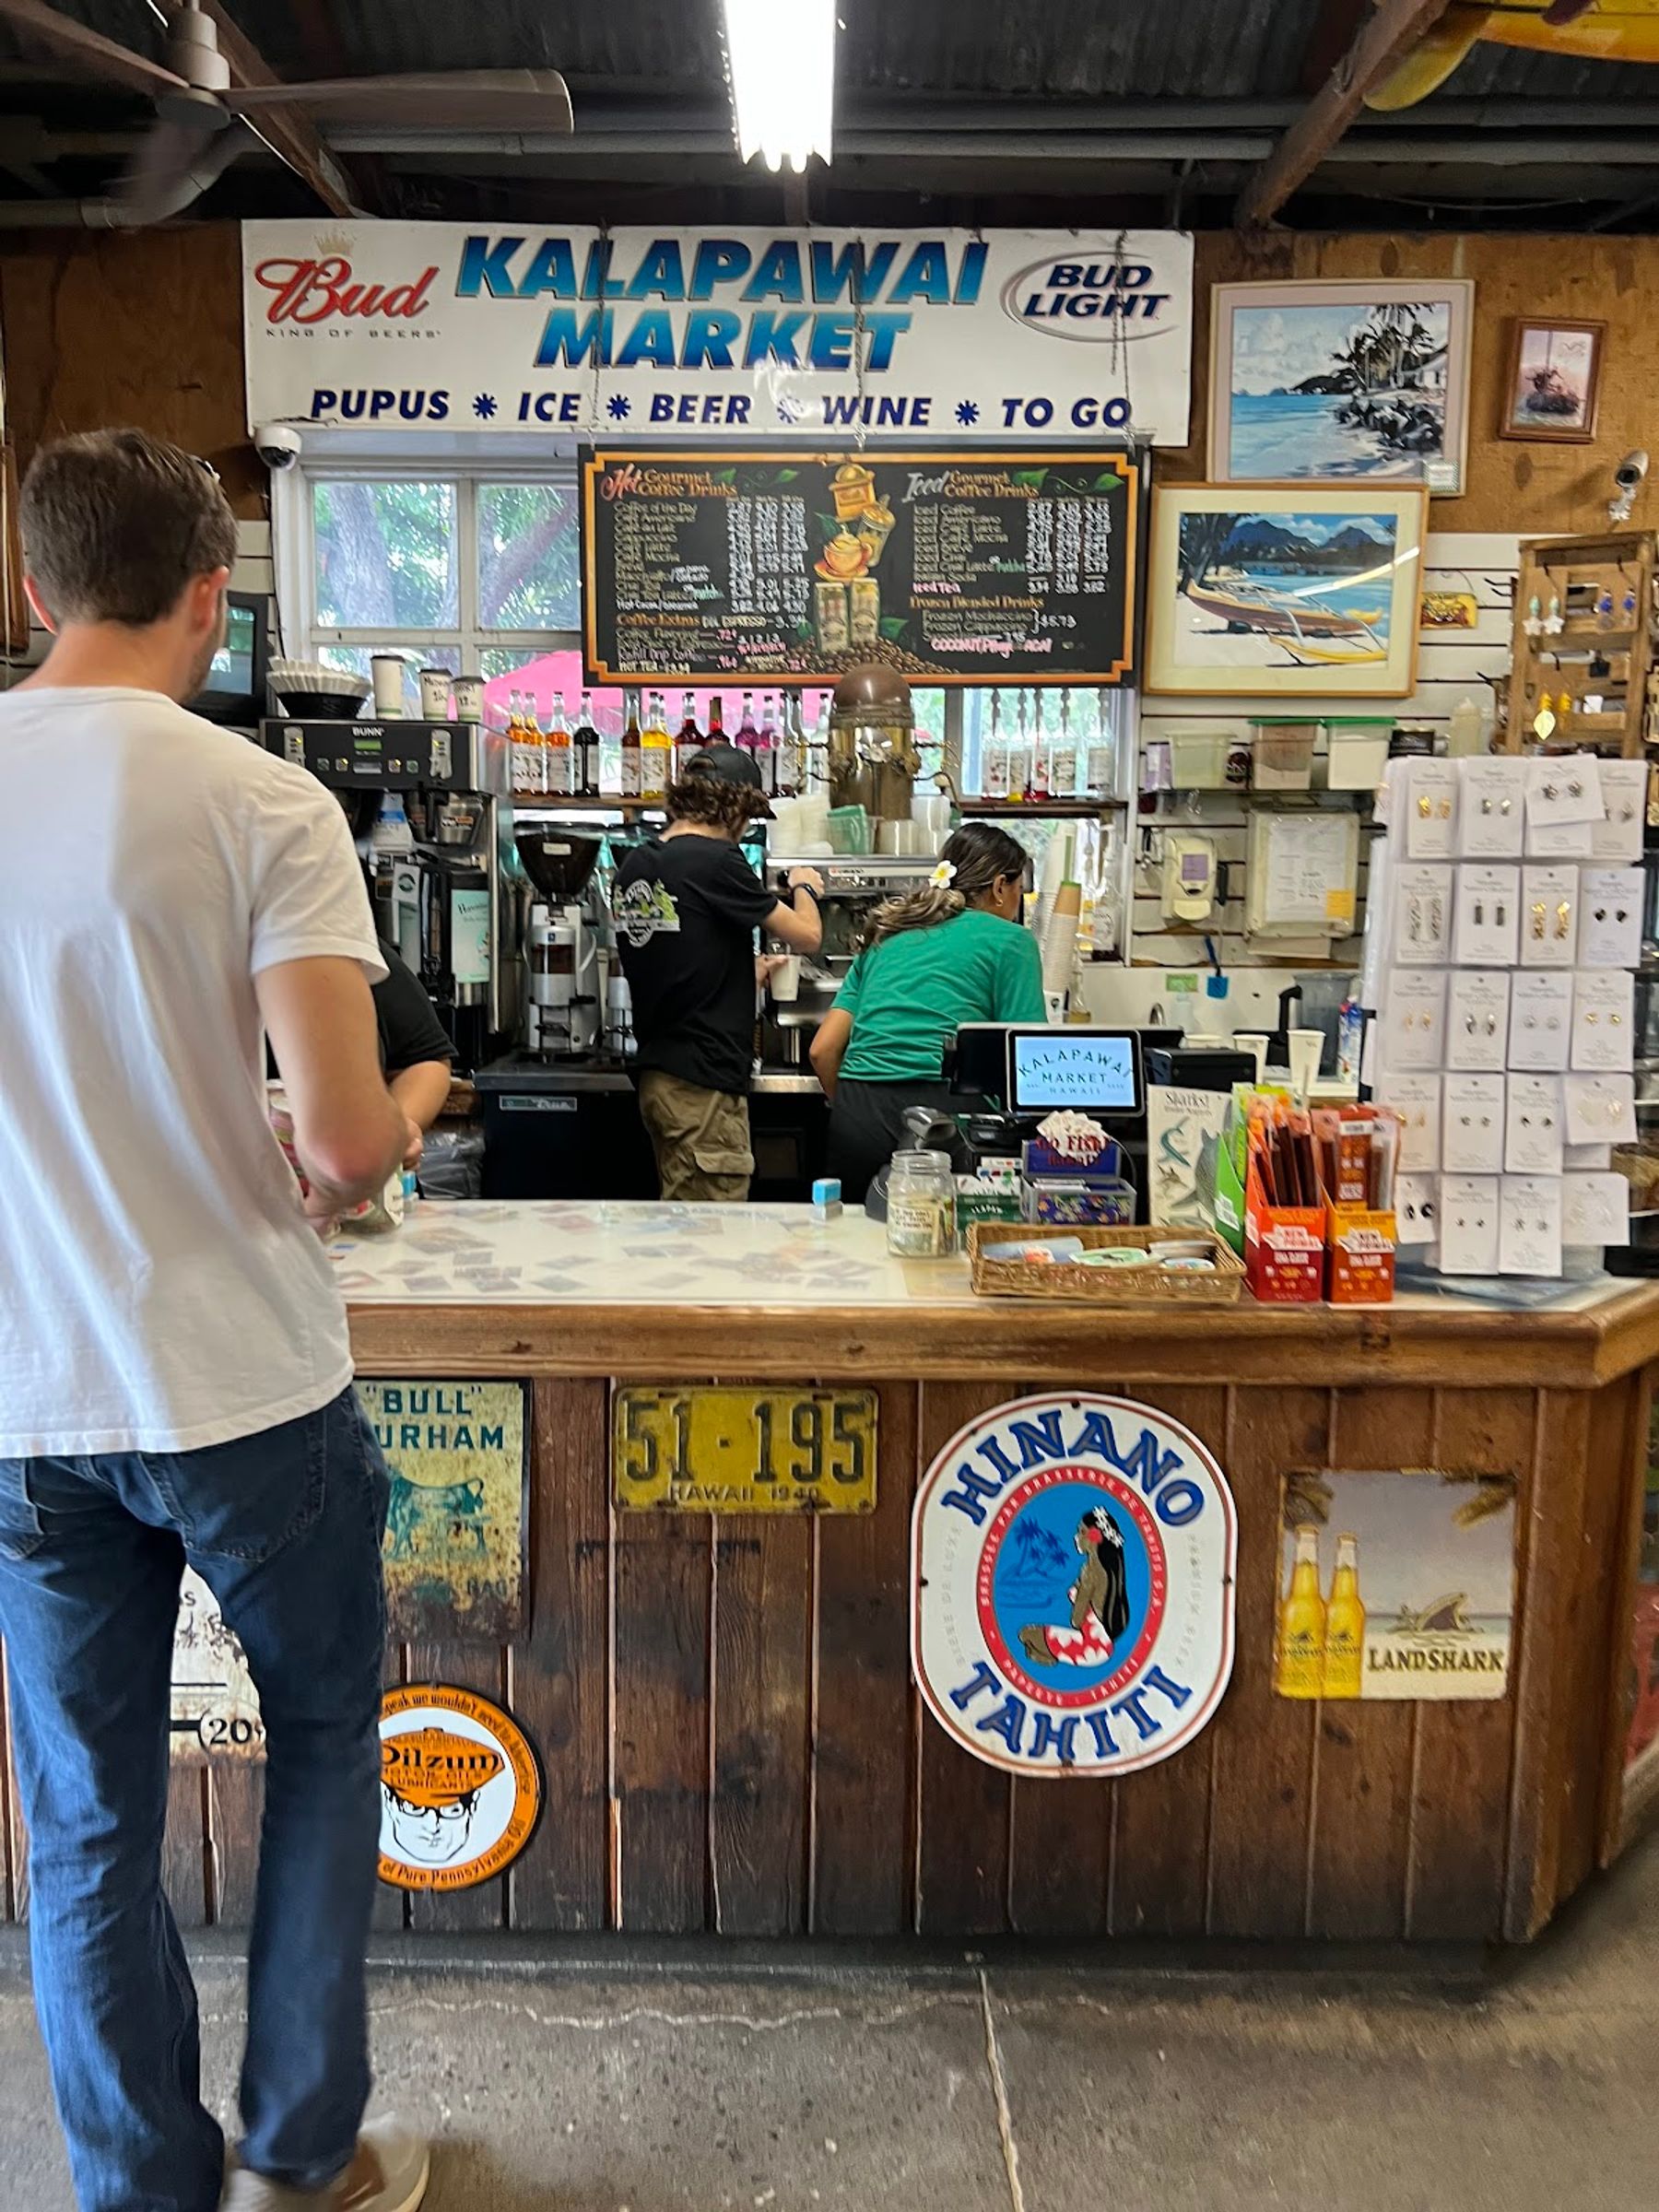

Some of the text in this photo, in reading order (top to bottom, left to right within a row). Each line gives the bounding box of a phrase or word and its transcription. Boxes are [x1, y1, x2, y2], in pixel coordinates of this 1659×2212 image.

[455, 236, 990, 306] KALAPAWAI
[1046, 265, 1154, 288] BUD
[255, 257, 441, 324] Bud
[1023, 293, 1173, 318] LIGHT
[265, 328, 314, 338] KING
[329, 328, 354, 338] OF
[534, 310, 912, 371] MARKET
[311, 388, 1133, 429] PUPUS ICE BEER WINE TO GO
[601, 463, 643, 501] Hot
[638, 481, 738, 498] Coffee Drinks
[644, 468, 712, 485] Gourmet
[901, 470, 951, 503] Iced
[950, 469, 1012, 485] Gourmet
[944, 483, 1040, 499] Coffee Drinks
[352, 726, 382, 736] BUNN
[1018, 1049, 1134, 1077] KALAPAWAI
[1041, 1072, 1108, 1084] MARKET
[374, 1424, 504, 1450] URHAM
[941, 1407, 1206, 1528] HINANO
[1366, 1646, 1504, 1673] LANDSHARK
[948, 1662, 1194, 1761] TAHITI
